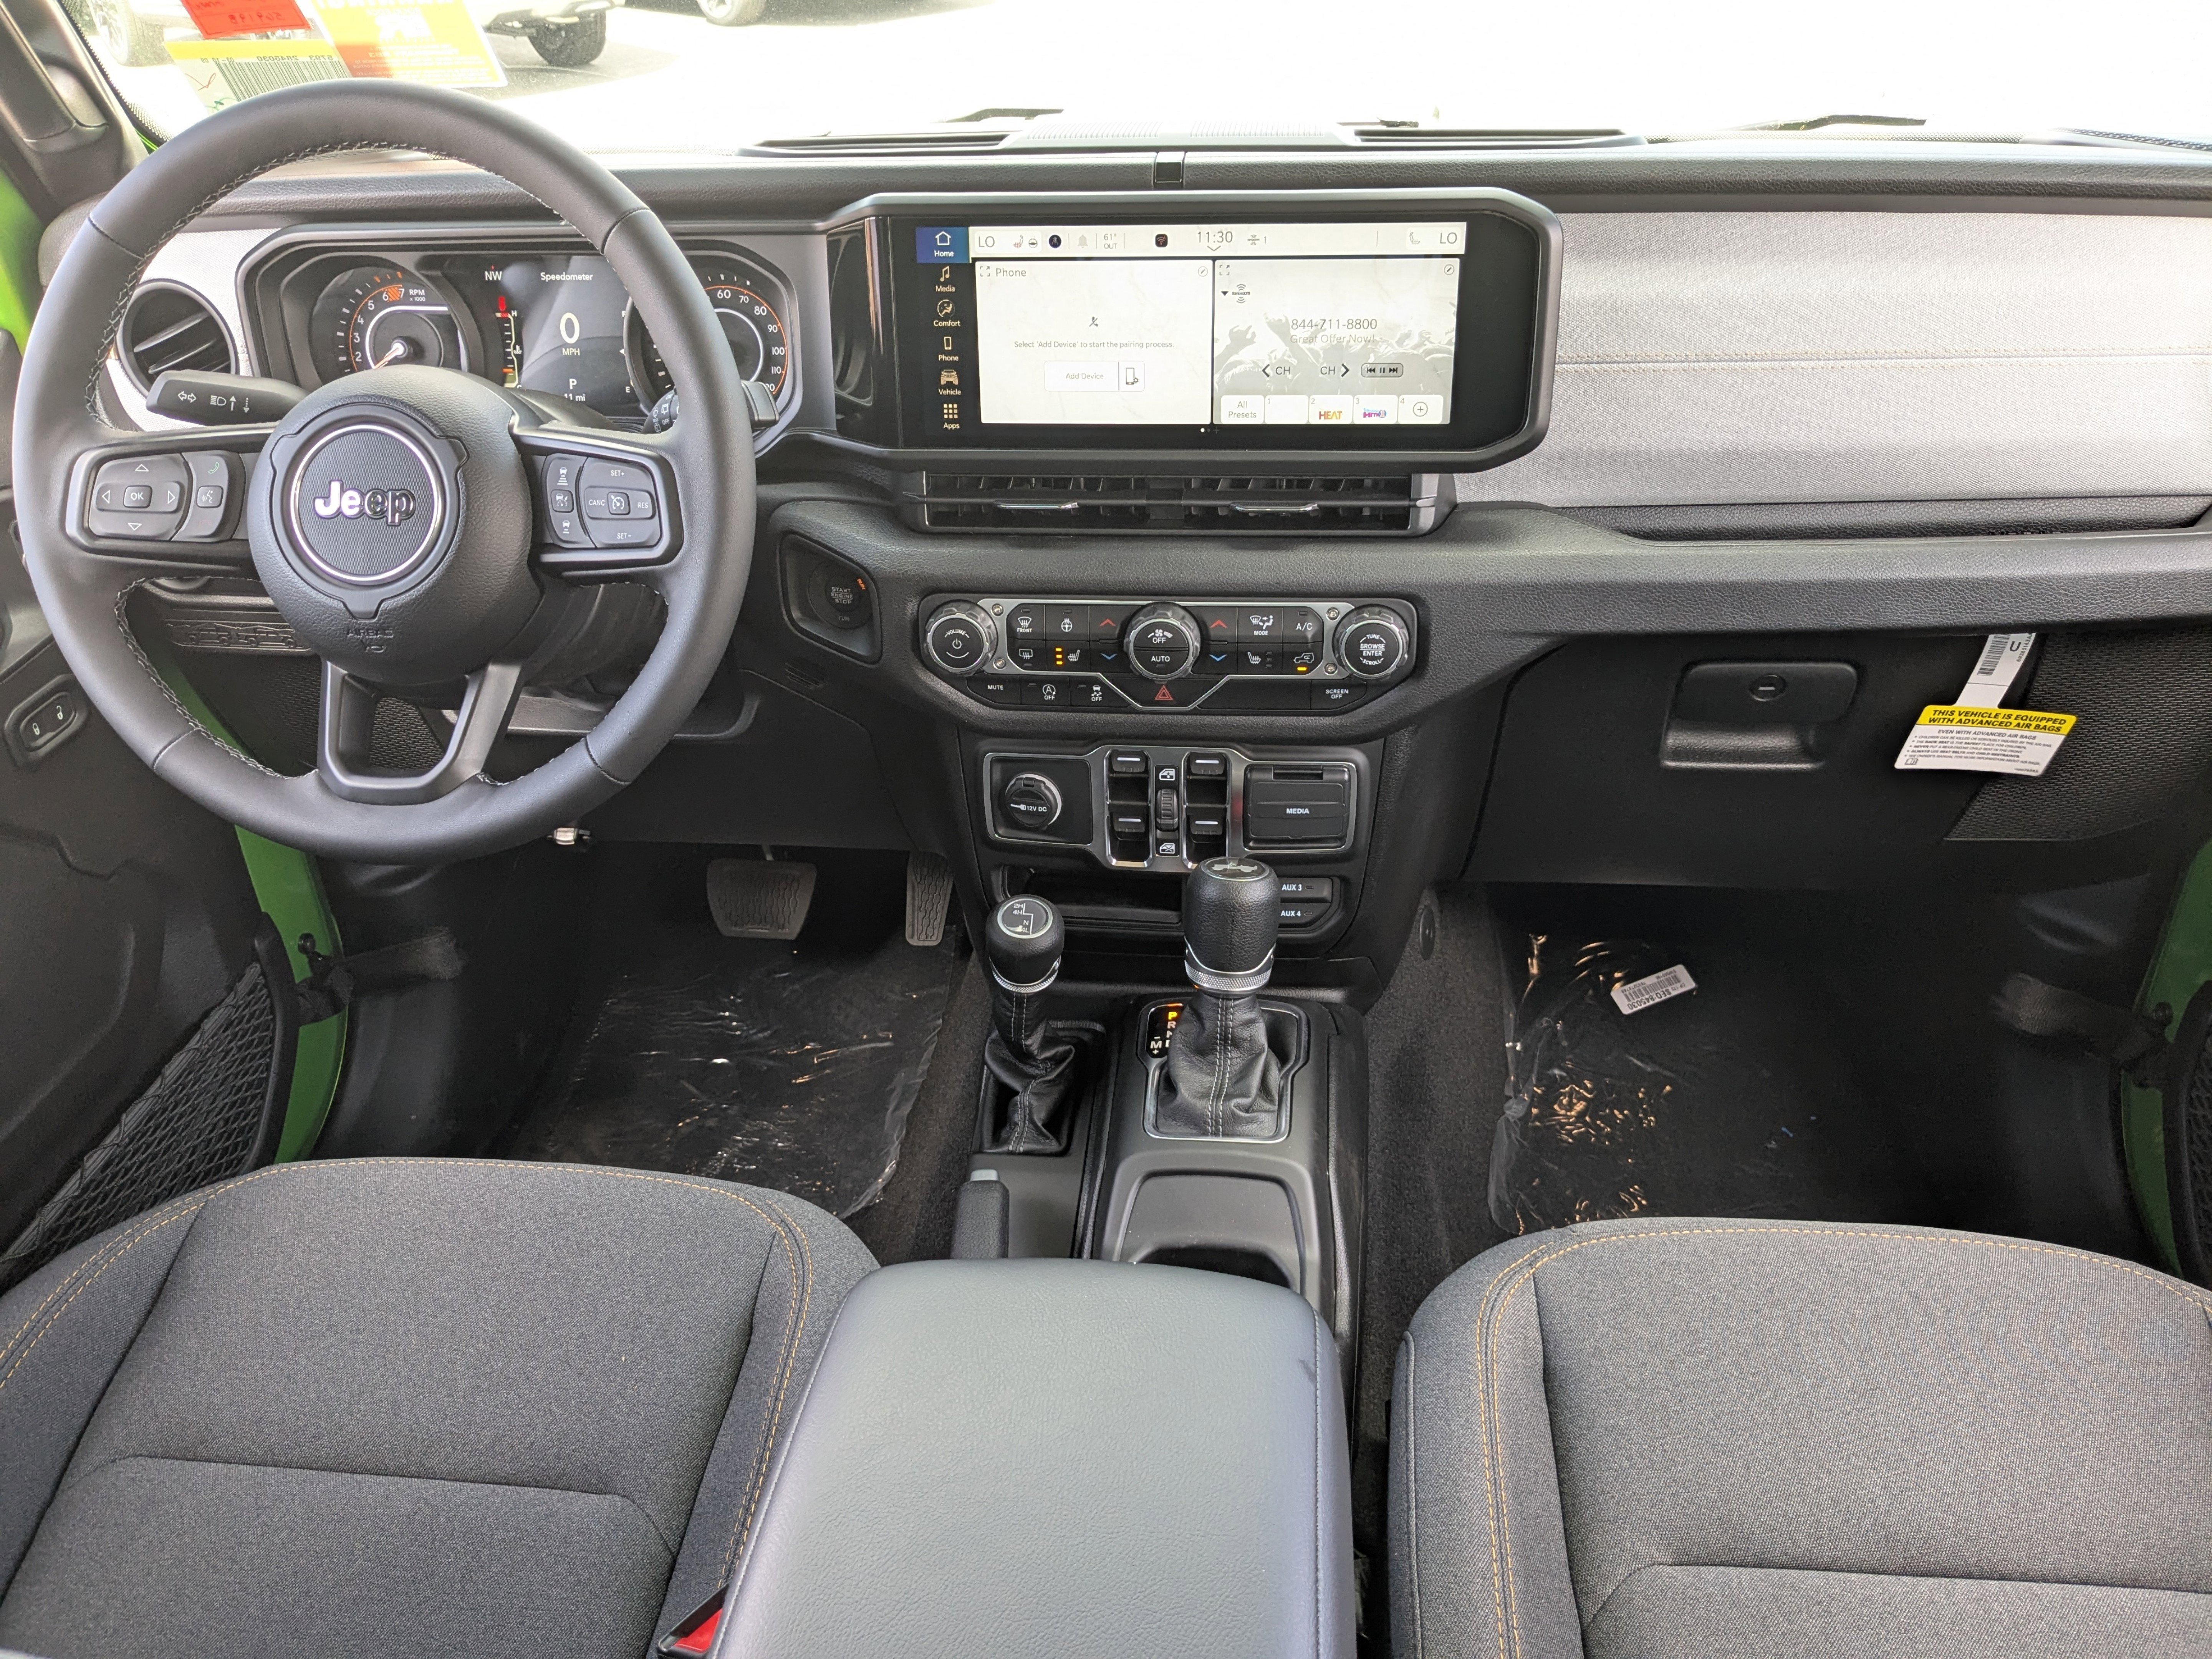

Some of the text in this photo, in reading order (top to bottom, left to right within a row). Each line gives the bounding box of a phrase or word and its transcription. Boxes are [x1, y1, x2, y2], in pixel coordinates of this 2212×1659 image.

[1197, 231, 1233, 243] 11:30
[1440, 232, 1457, 244] LO
[979, 237, 995, 248] LO
[485, 271, 502, 281] NW
[540, 272, 593, 281] Speedometer
[995, 268, 1027, 277] Phone
[382, 291, 389, 301] 6
[399, 288, 405, 298] 7
[717, 290, 731, 299] 60
[738, 295, 749, 303] 70
[368, 300, 375, 310] 5
[754, 306, 767, 315] 80
[357, 315, 364, 325] 4
[1291, 318, 1378, 330] 844-711-8800
[560, 312, 579, 343] 0
[767, 325, 778, 333] 90
[354, 333, 360, 343] 3
[1290, 334, 1375, 343] Great Offer Now!
[1119, 341, 1144, 349] pairing
[355, 351, 362, 361] 2
[772, 347, 785, 355] 100
[1275, 366, 1290, 376] CH
[1320, 366, 1336, 376] CH
[569, 379, 577, 389] P
[1228, 411, 1257, 419] Presets
[1319, 411, 1342, 419] HEAT
[131, 492, 144, 500] OK
[314, 480, 416, 526] Jeep
[857, 578, 866, 589] RUN
[1296, 623, 1312, 631] A/C
[2010, 641, 2021, 652] U
[1958, 710, 2001, 719] VEHICLE
[2014, 714, 2066, 725] EQUIPPED
[1955, 718, 2012, 727] ADVANCED
[2033, 724, 2062, 732] BAGS
